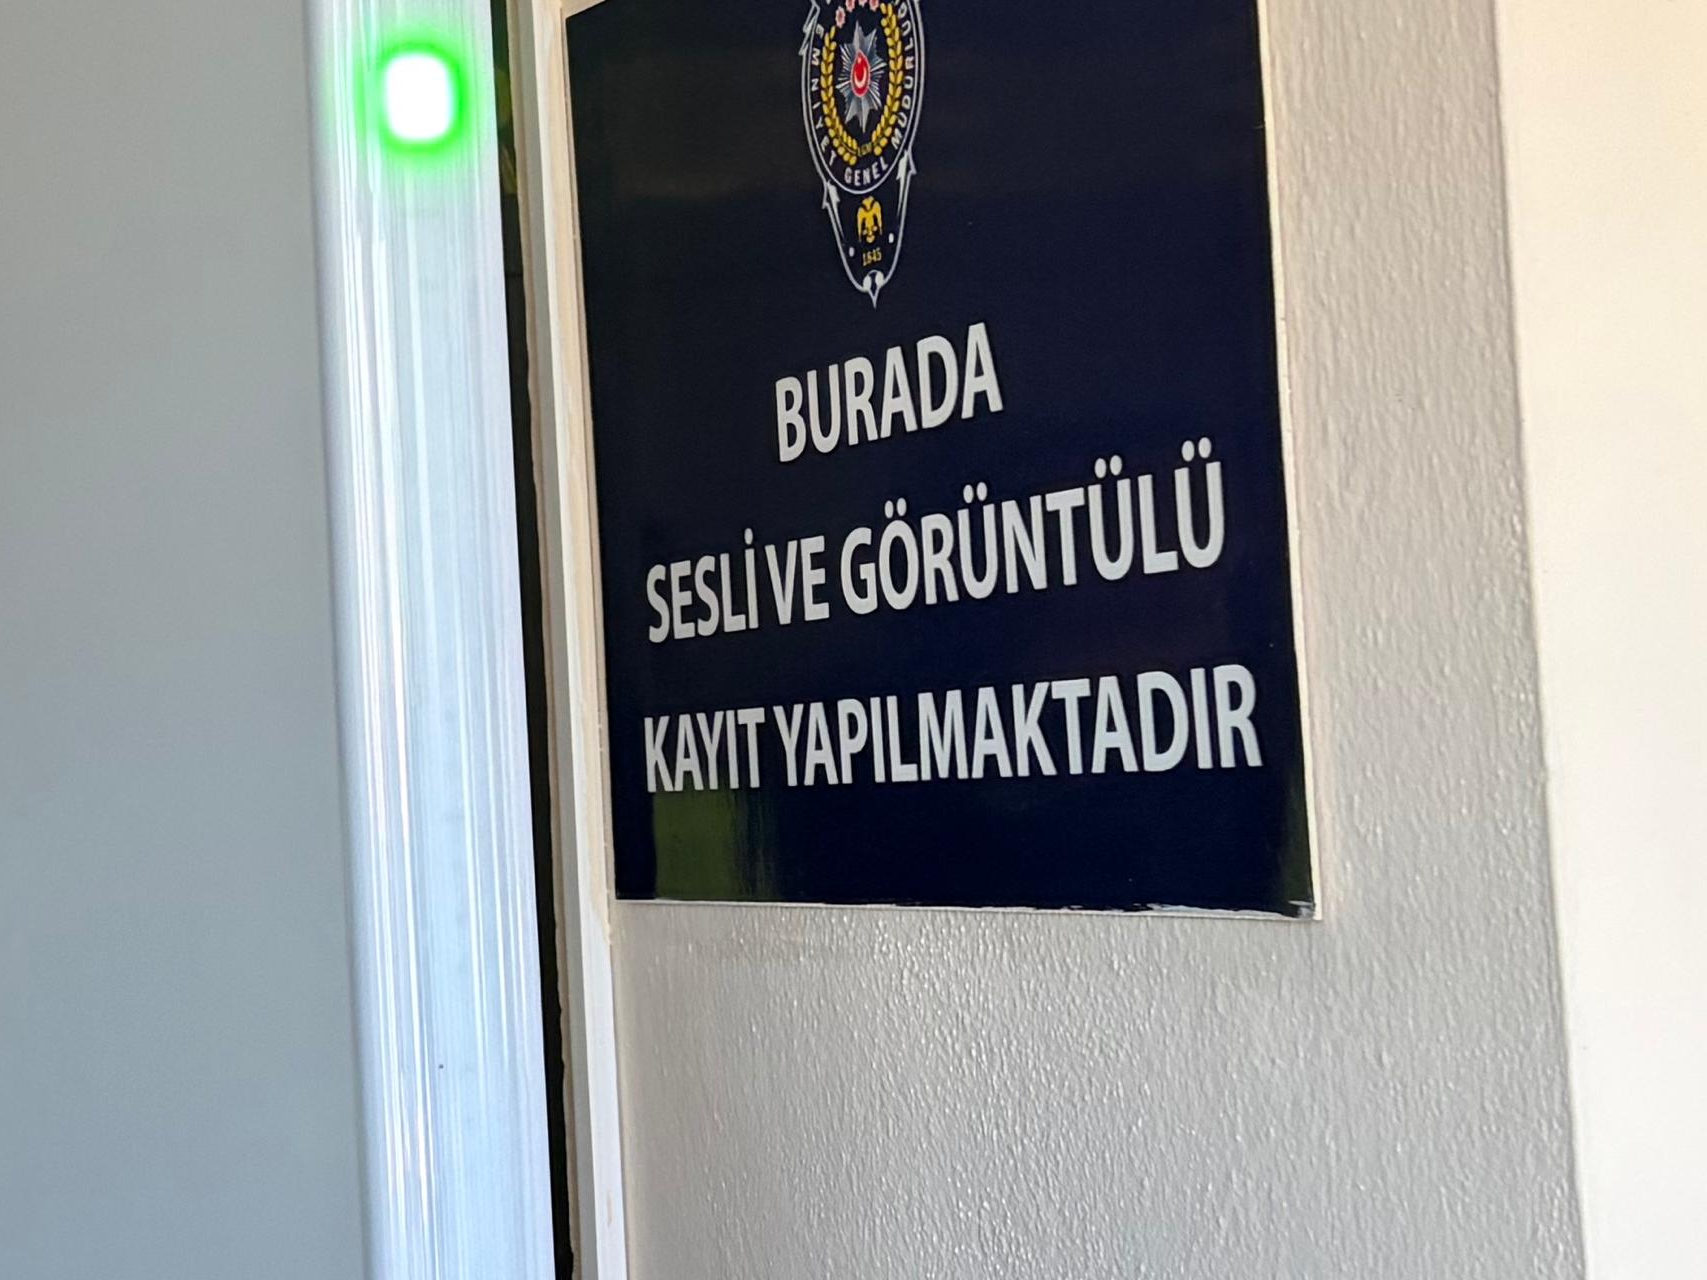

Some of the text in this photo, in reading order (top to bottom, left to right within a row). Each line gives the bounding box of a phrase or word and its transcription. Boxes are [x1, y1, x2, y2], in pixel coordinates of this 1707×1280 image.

[844, 155, 889, 187] GENEL
[775, 322, 1004, 462] BURADA
[646, 436, 1225, 643] SESLİ VE GÖRÜNTÜLÜ
[643, 663, 1264, 793] KAYIT YAPILMAKTADIR
